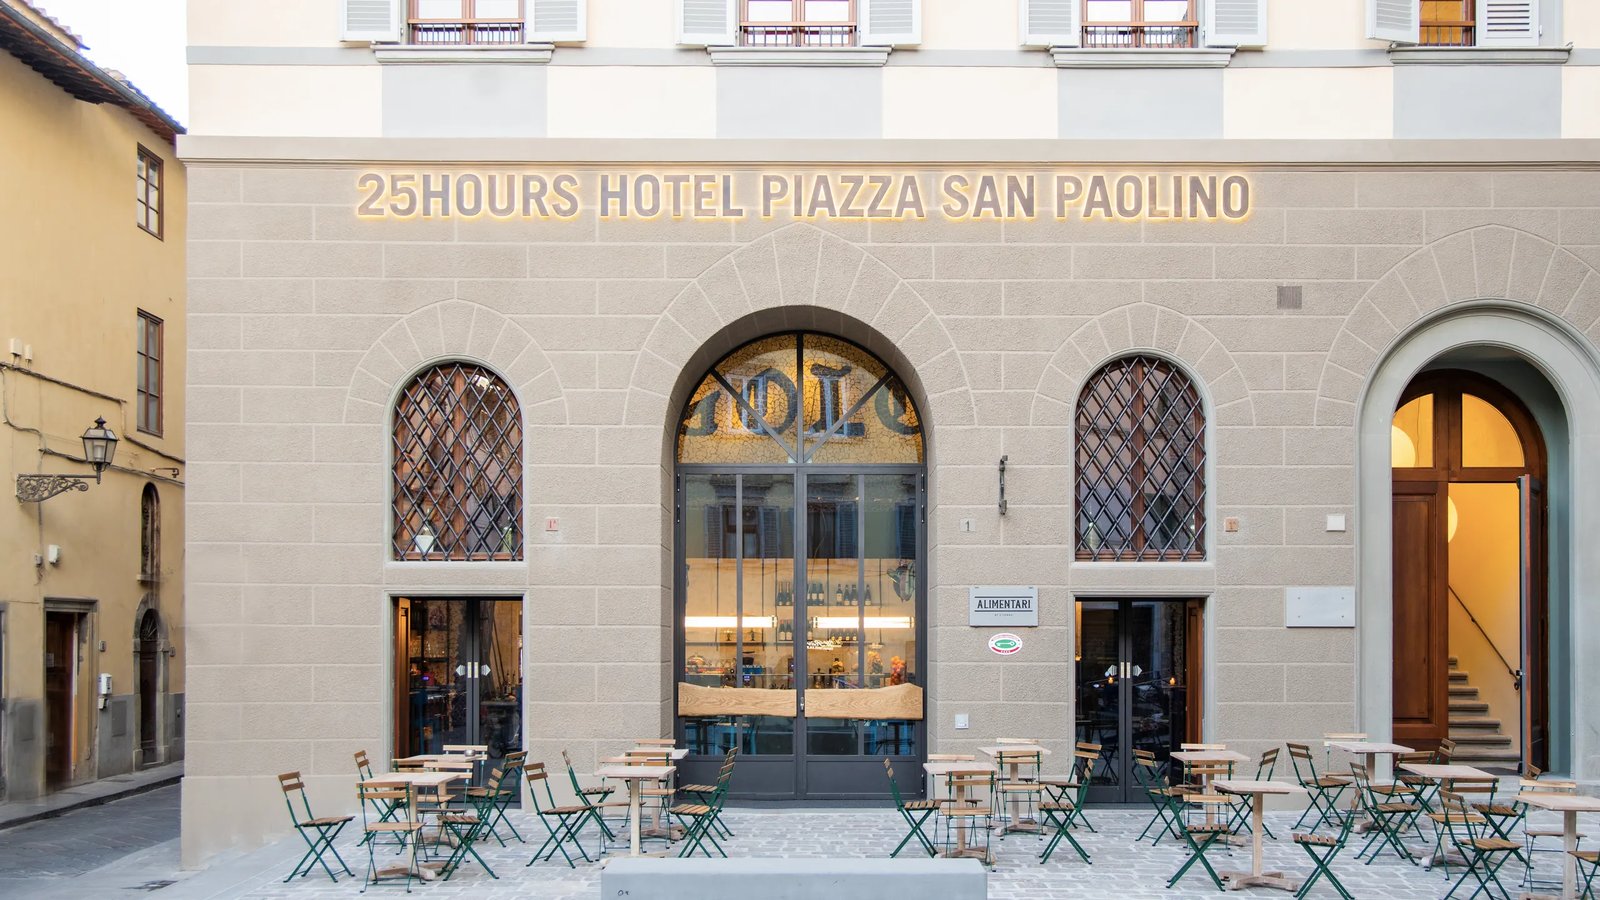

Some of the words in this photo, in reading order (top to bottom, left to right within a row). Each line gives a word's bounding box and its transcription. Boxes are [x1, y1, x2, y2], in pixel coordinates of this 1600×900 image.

[357, 173, 579, 217] 25HOURS
[600, 174, 744, 217] HOTEL
[762, 175, 924, 218] PIAZZA
[942, 175, 1034, 218] SAN
[1057, 175, 1250, 218] PAOLINO
[977, 599, 1031, 609] ALIMENTARI
